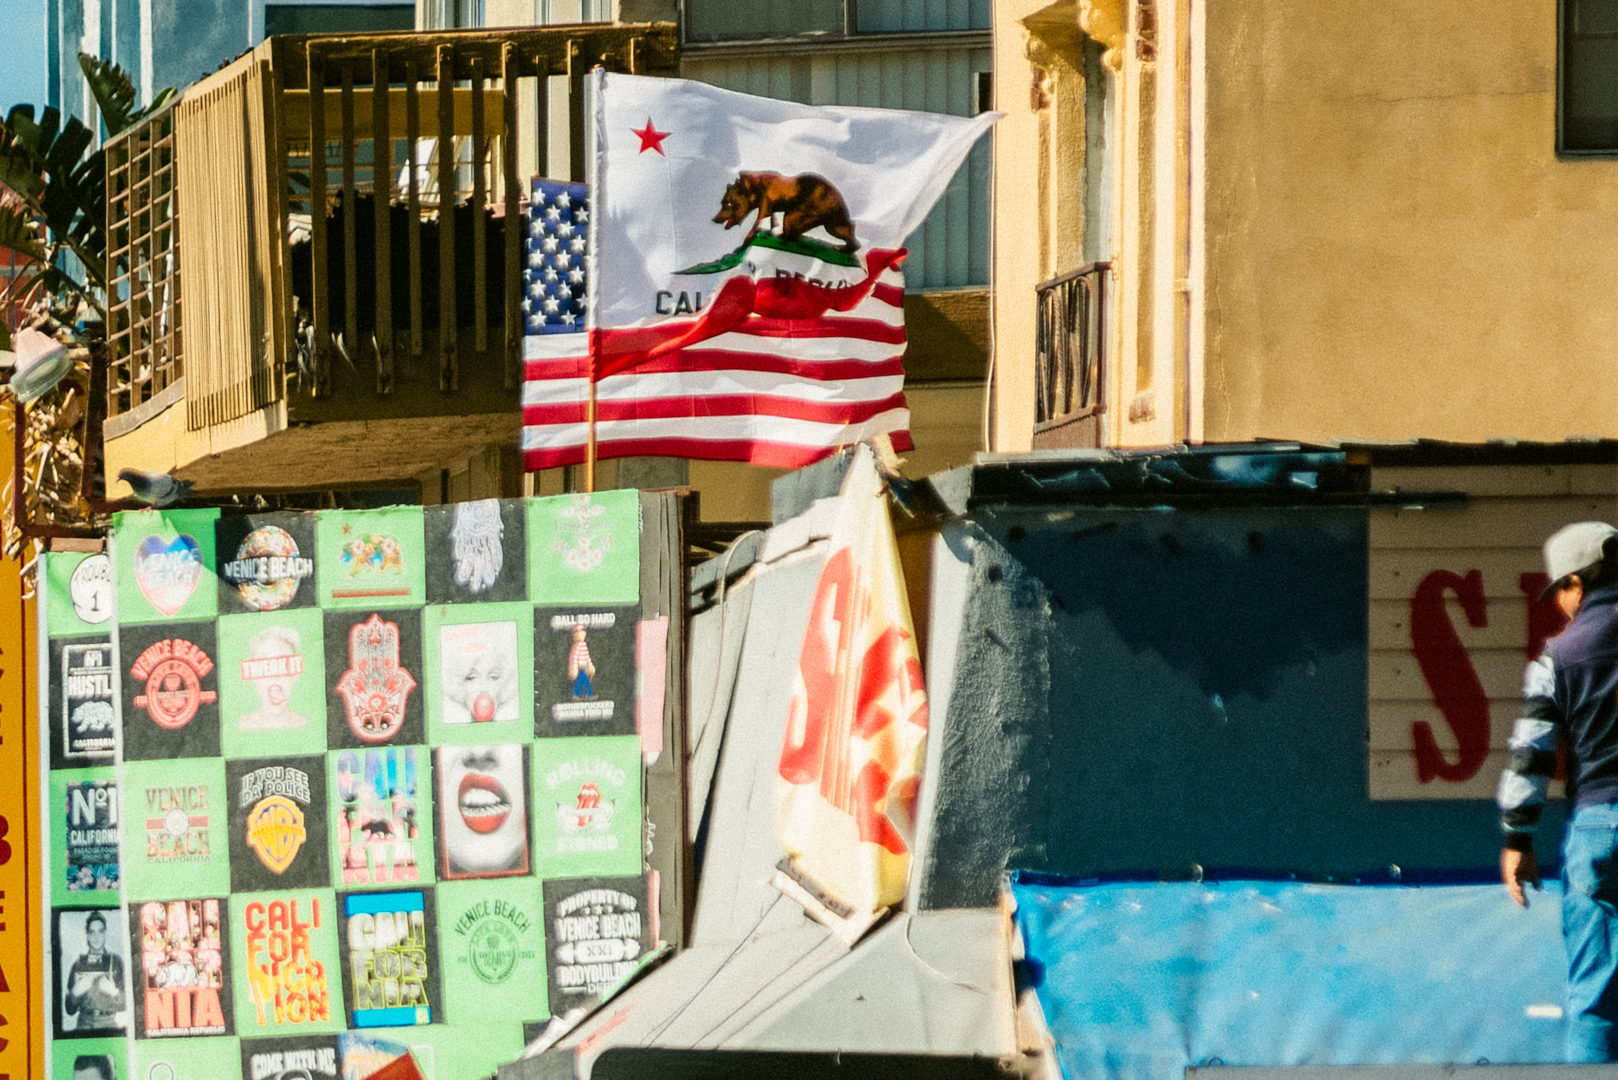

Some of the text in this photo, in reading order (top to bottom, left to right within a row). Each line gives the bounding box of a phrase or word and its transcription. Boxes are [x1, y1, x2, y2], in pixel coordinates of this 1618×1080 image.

[225, 555, 313, 579] VENICE BEACH
[555, 613, 615, 626] BALL SO HARD
[131, 638, 214, 680] VENICE BEACH
[242, 656, 303, 679] TWERK IT
[242, 767, 310, 788] IF YOU SEE
[266, 780, 311, 805] POLICE
[145, 785, 210, 812] VENICE
[146, 828, 211, 857] BEACH
[245, 898, 322, 932] CALI
[455, 901, 491, 936] VENICE
[494, 900, 532, 934] BEACH
[555, 912, 641, 942] VENICE BEACH
[348, 911, 426, 951] CALI
[247, 929, 312, 964] FOR
[351, 948, 428, 981] FOR
[355, 978, 430, 1010] NIA
[144, 989, 226, 1030] NIA
[284, 1049, 318, 1071] WITH
[320, 1047, 336, 1075] ME
